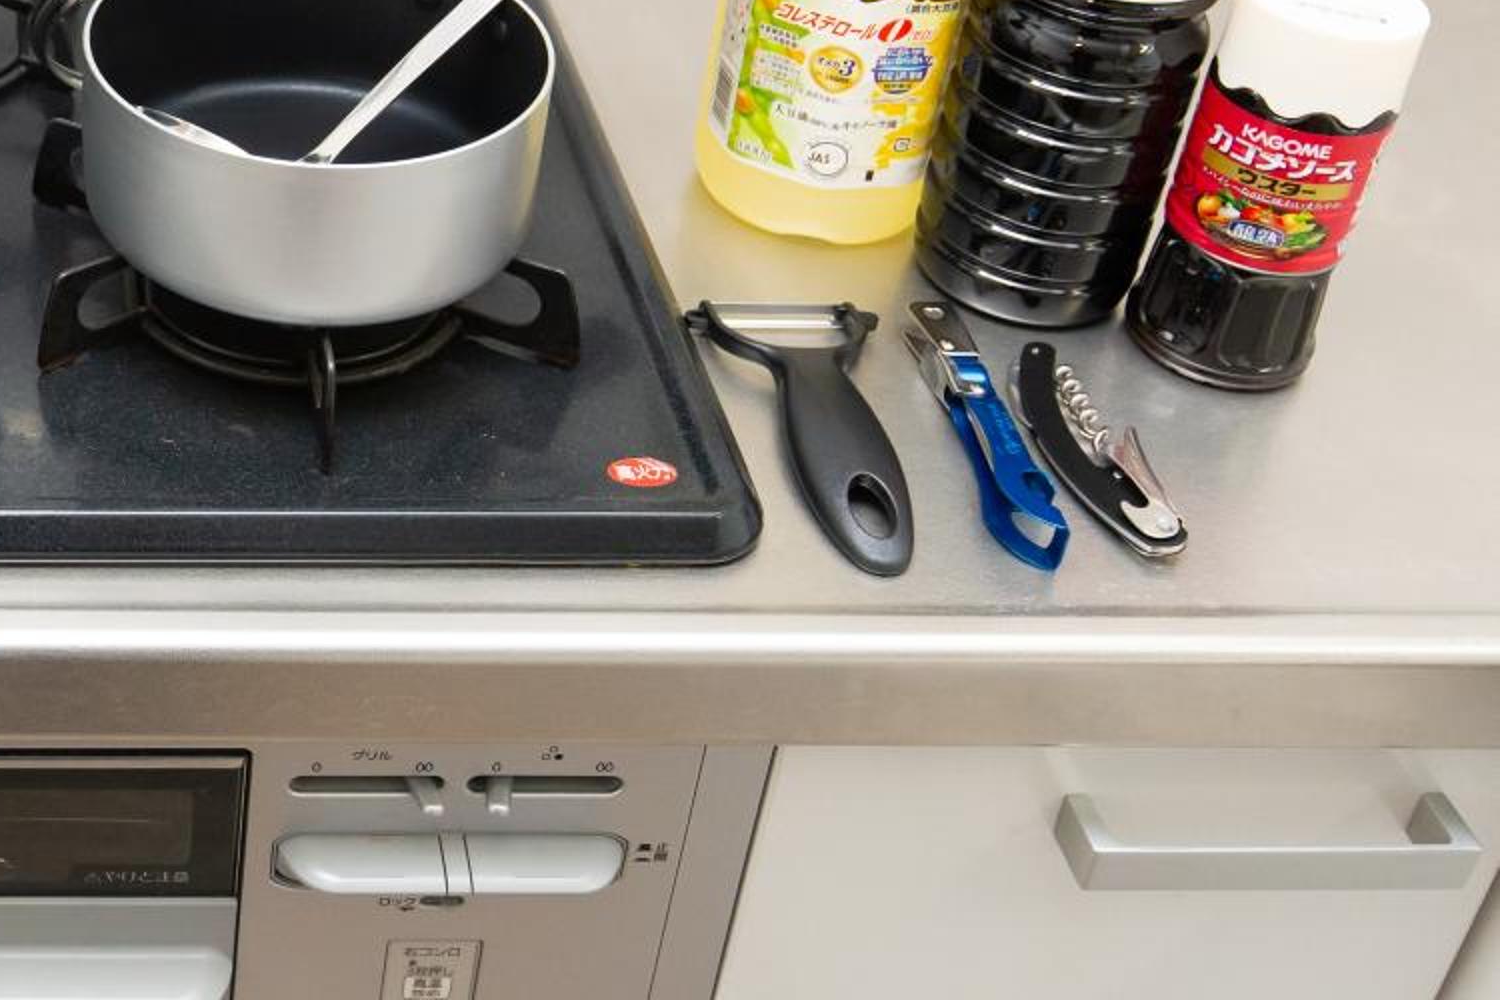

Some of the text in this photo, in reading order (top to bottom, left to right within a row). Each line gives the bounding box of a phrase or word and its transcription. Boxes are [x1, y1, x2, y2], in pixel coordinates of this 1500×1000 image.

[1208, 123, 1359, 184] カゴメソース
[1241, 123, 1333, 160] KAGOME
[1236, 167, 1317, 196] ウスター
